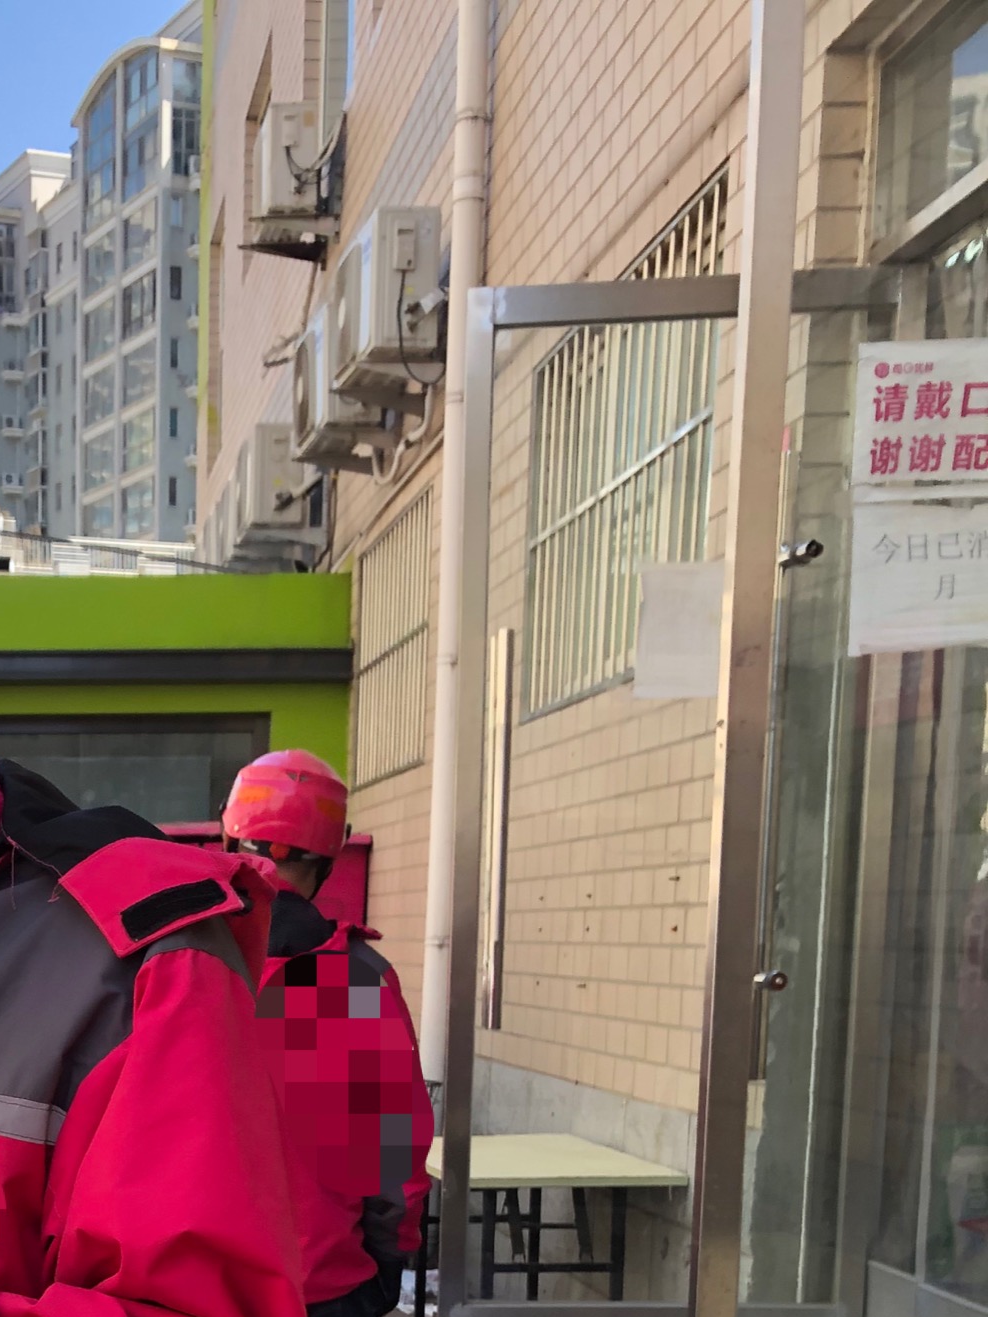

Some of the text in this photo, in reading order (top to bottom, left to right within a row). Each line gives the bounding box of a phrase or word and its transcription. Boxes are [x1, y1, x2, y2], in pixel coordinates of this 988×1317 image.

[873, 381, 988, 422] 请戴口
[870, 433, 988, 475] 谢谢配
[934, 574, 955, 600] 月
